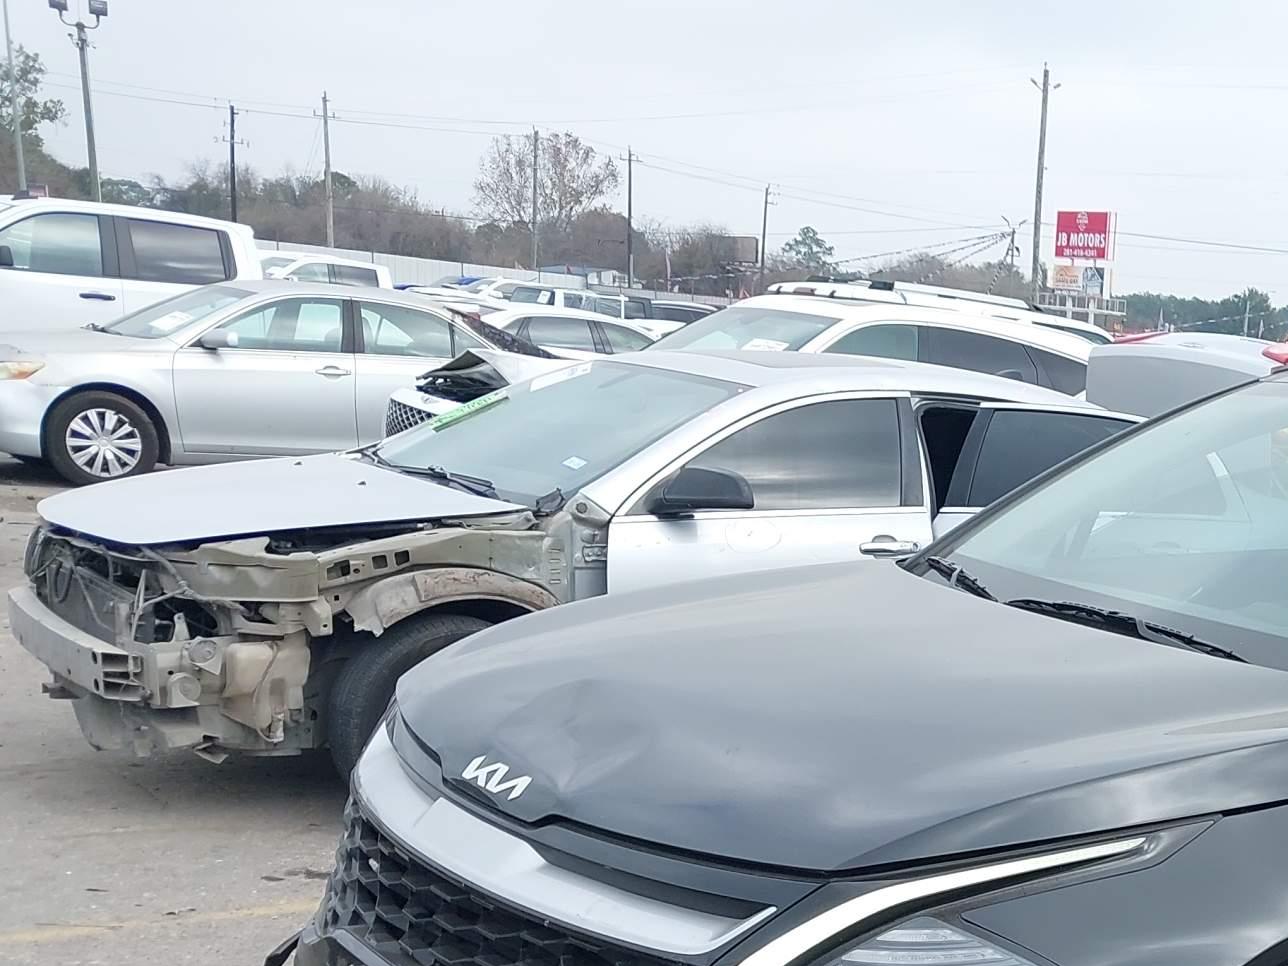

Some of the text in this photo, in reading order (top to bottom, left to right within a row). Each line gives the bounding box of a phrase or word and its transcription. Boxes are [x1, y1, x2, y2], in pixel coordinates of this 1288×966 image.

[1057, 231, 1106, 248] JB MOTORS
[461, 754, 533, 801] KIA
